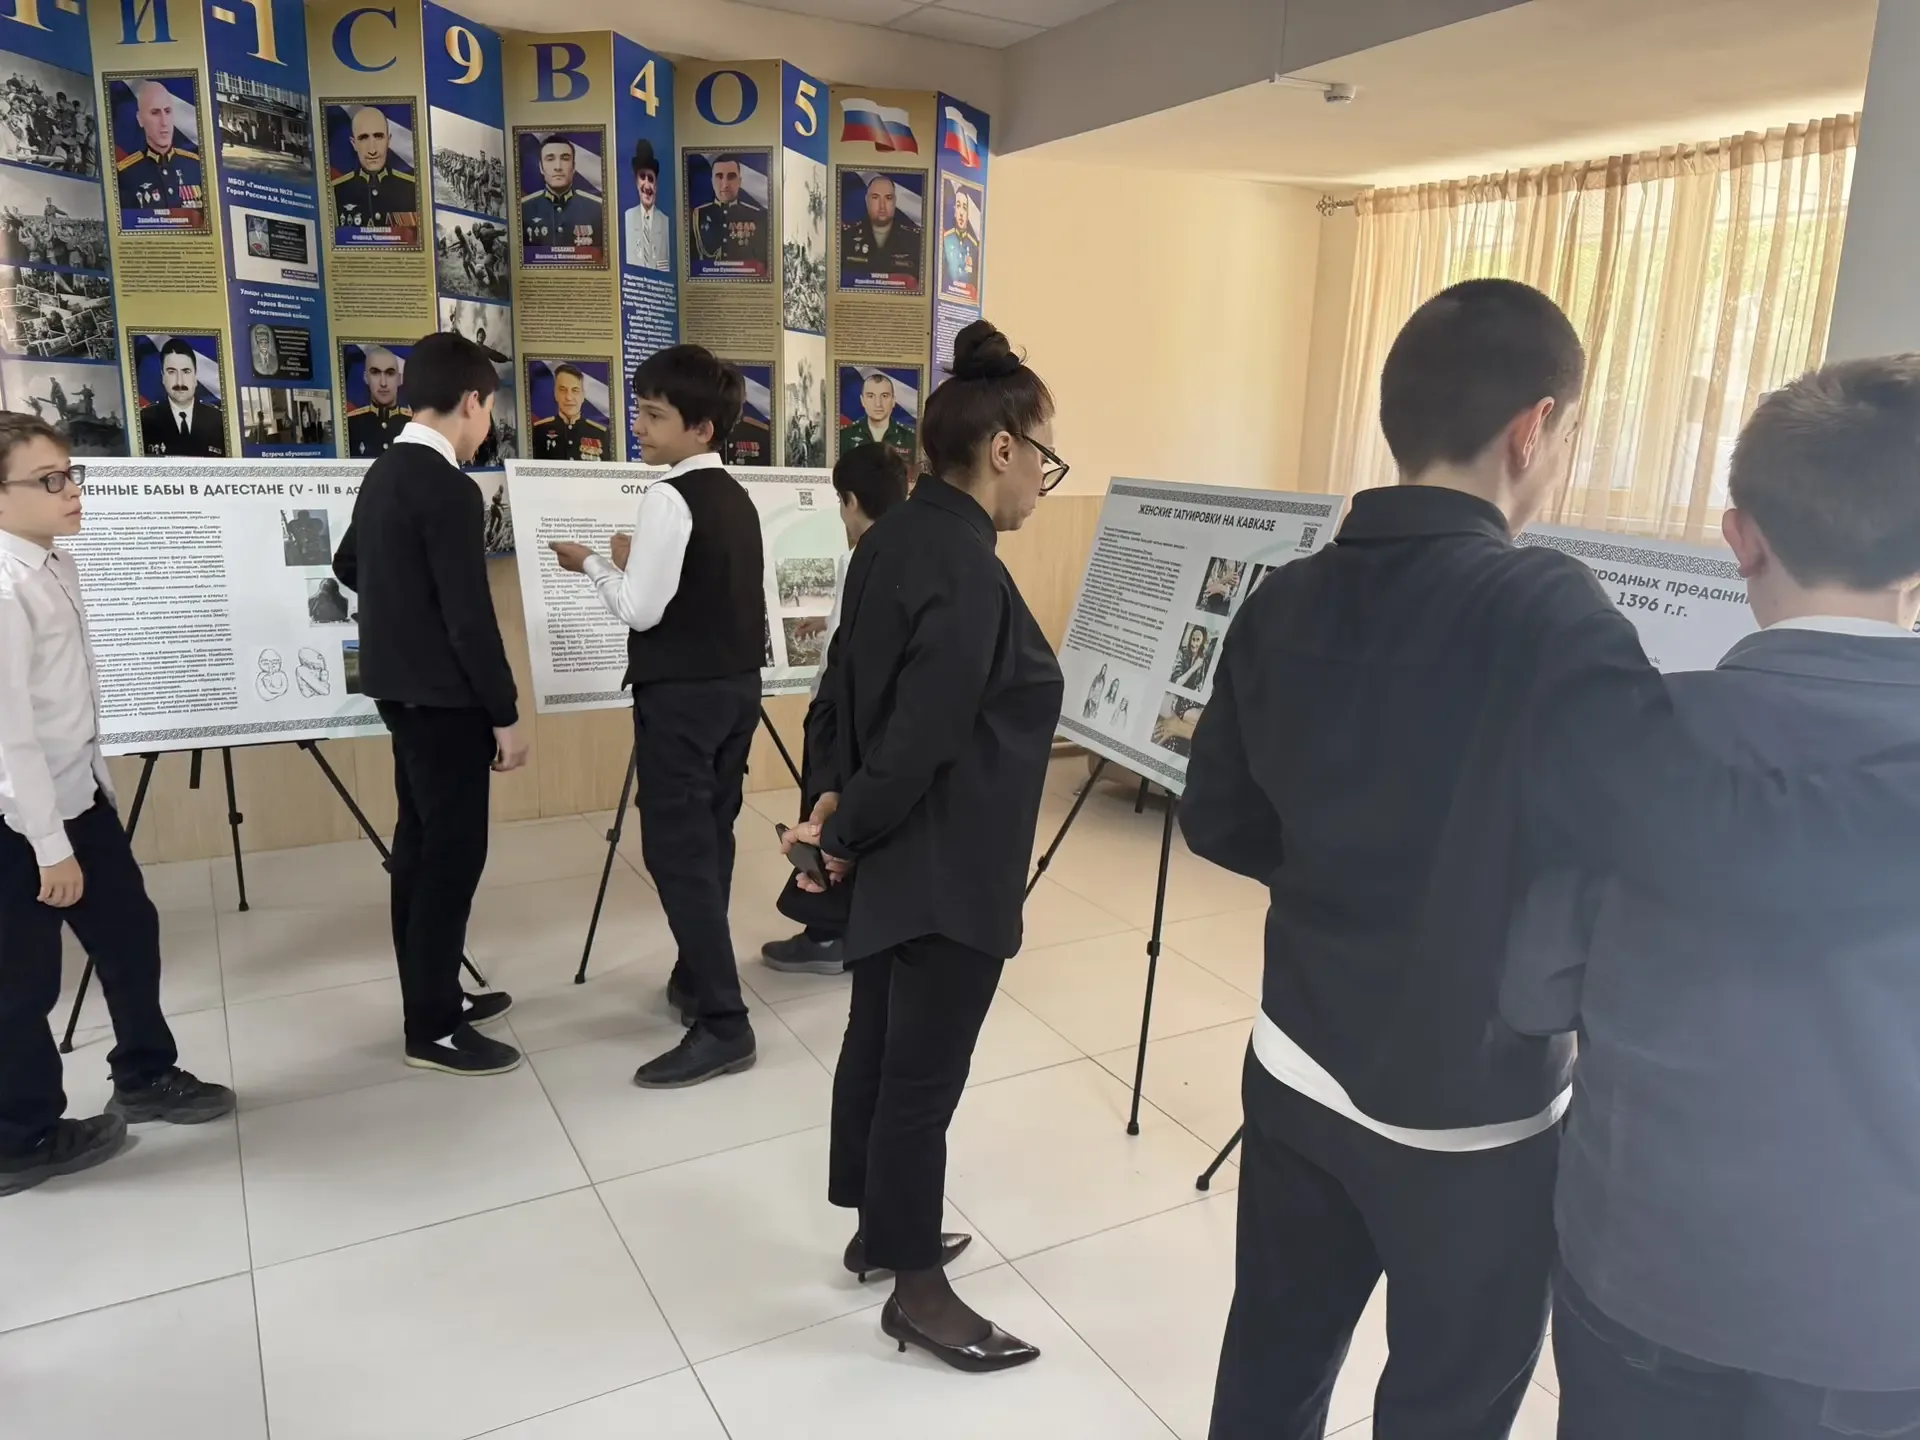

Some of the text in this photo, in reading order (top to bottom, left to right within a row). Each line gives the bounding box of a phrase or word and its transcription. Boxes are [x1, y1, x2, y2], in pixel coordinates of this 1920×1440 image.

[332, 7, 397, 72] С
[445, 25, 483, 84] 9
[528, 43, 590, 102] В
[630, 60, 659, 117] 4
[695, 70, 758, 125] О
[795, 80, 817, 136] 5
[228, 177, 245, 186] МБОУ
[143, 484, 184, 495] БАБЫ
[190, 484, 199, 495] В
[204, 484, 284, 496] ДАГЕСТАНЕ
[289, 484, 303, 496] (V
[1138, 504, 1276, 531] ЖЕНСКИЕ ТАТУИРОВКИ НА КАВКАЗЕ
[1616, 592, 1659, 612] 1396
